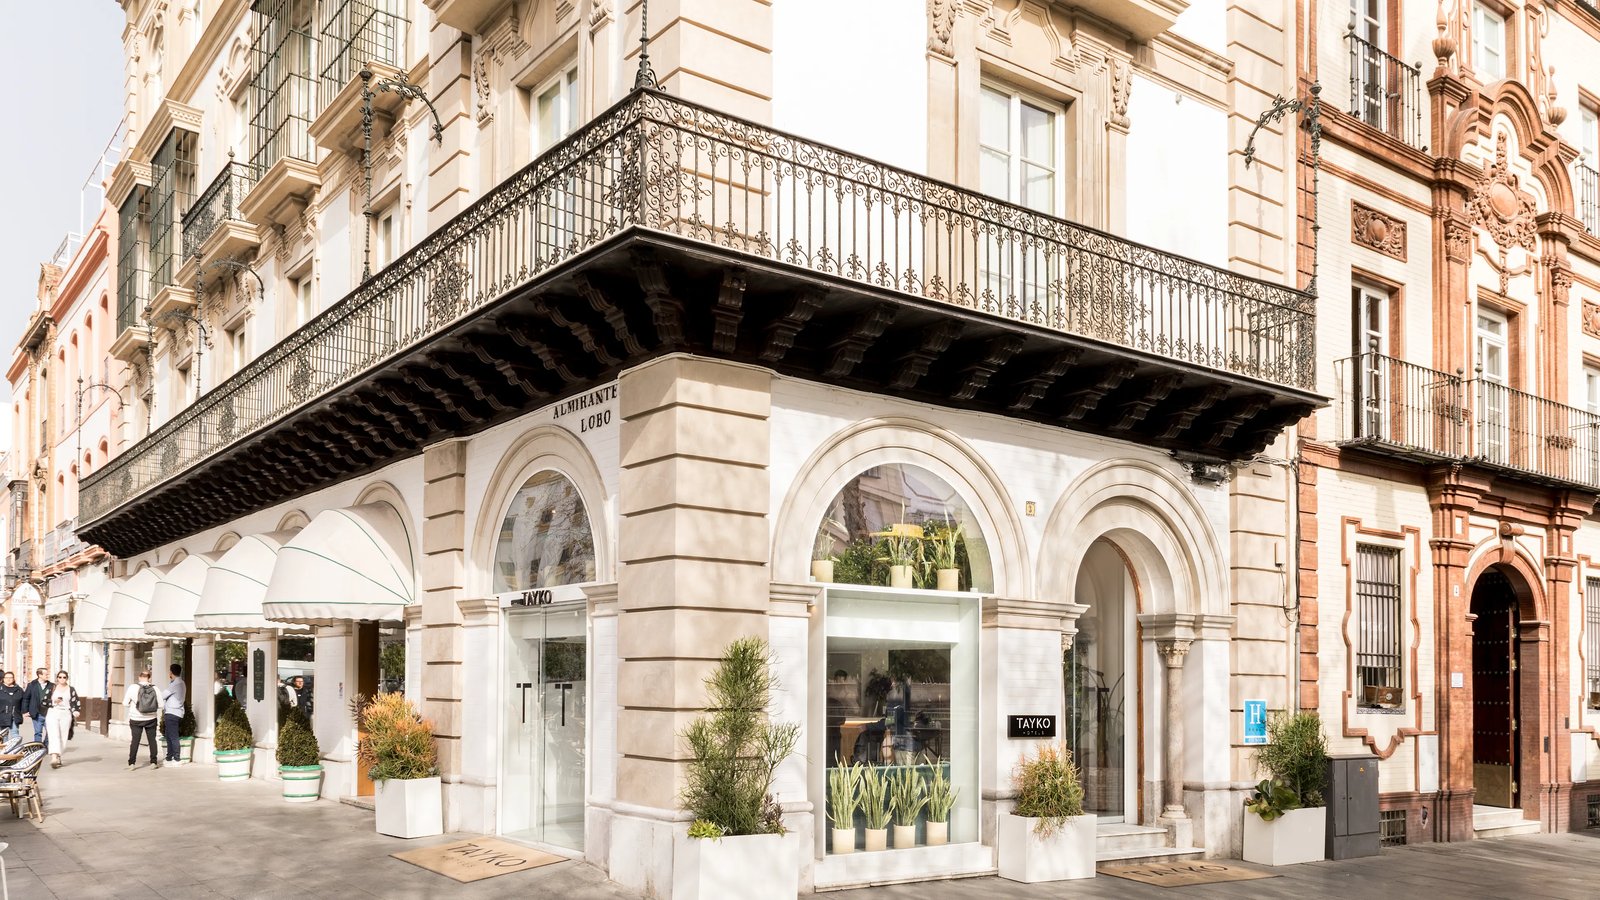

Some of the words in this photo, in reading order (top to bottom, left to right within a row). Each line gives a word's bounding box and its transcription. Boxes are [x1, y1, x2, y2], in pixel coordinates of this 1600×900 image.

[553, 384, 618, 419] ALMIRANTE
[580, 410, 612, 433] LOBO
[521, 590, 552, 606] TAYKO
[1016, 717, 1051, 729] TAYKO
[448, 842, 527, 867] TAYKO
